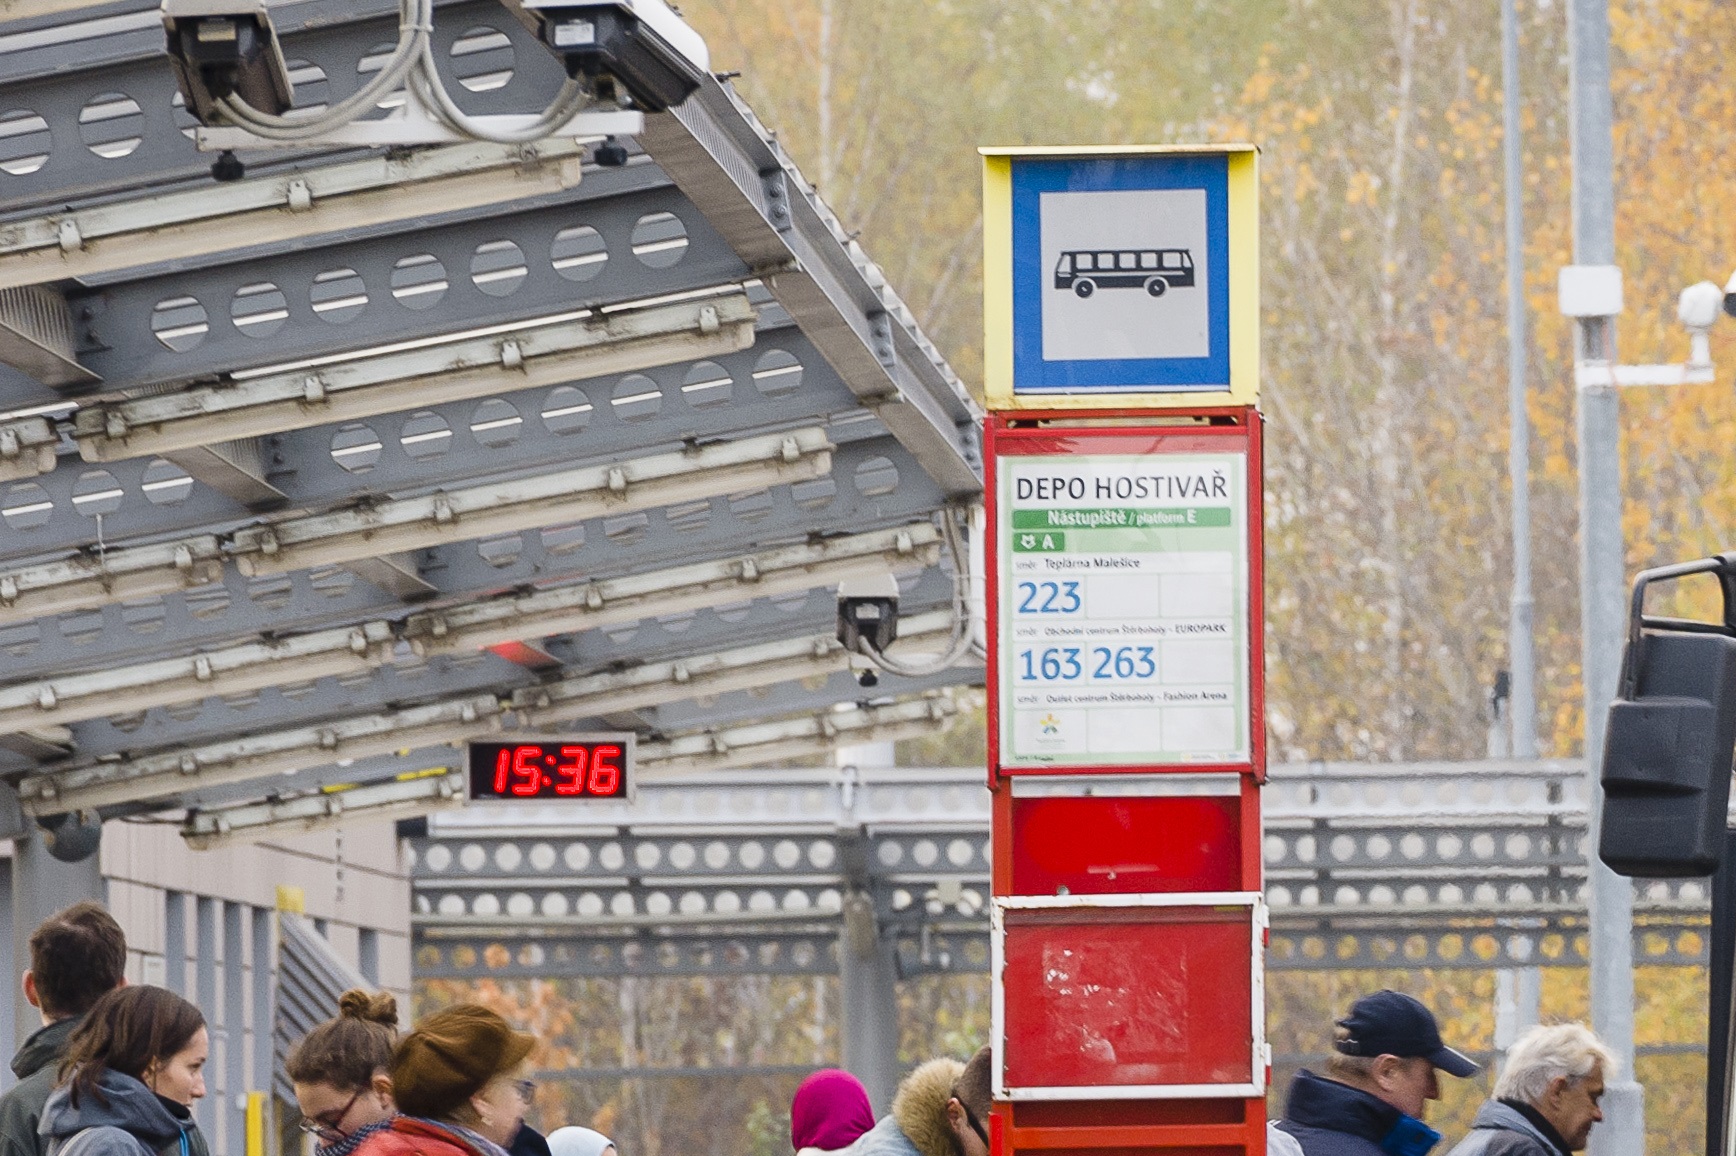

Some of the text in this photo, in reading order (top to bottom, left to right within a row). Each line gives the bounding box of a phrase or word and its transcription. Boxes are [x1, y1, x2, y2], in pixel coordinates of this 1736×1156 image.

[1016, 469, 1228, 501] DEPO HOSTIVAŘ
[1047, 508, 1127, 528] Nástupiště
[1136, 511, 1185, 527] platform
[1186, 508, 1198, 524] E
[1041, 533, 1056, 550] A
[1017, 581, 1082, 614] 223
[1020, 648, 1082, 680] 163
[1092, 646, 1156, 679] 263
[494, 745, 620, 796] 15:36
